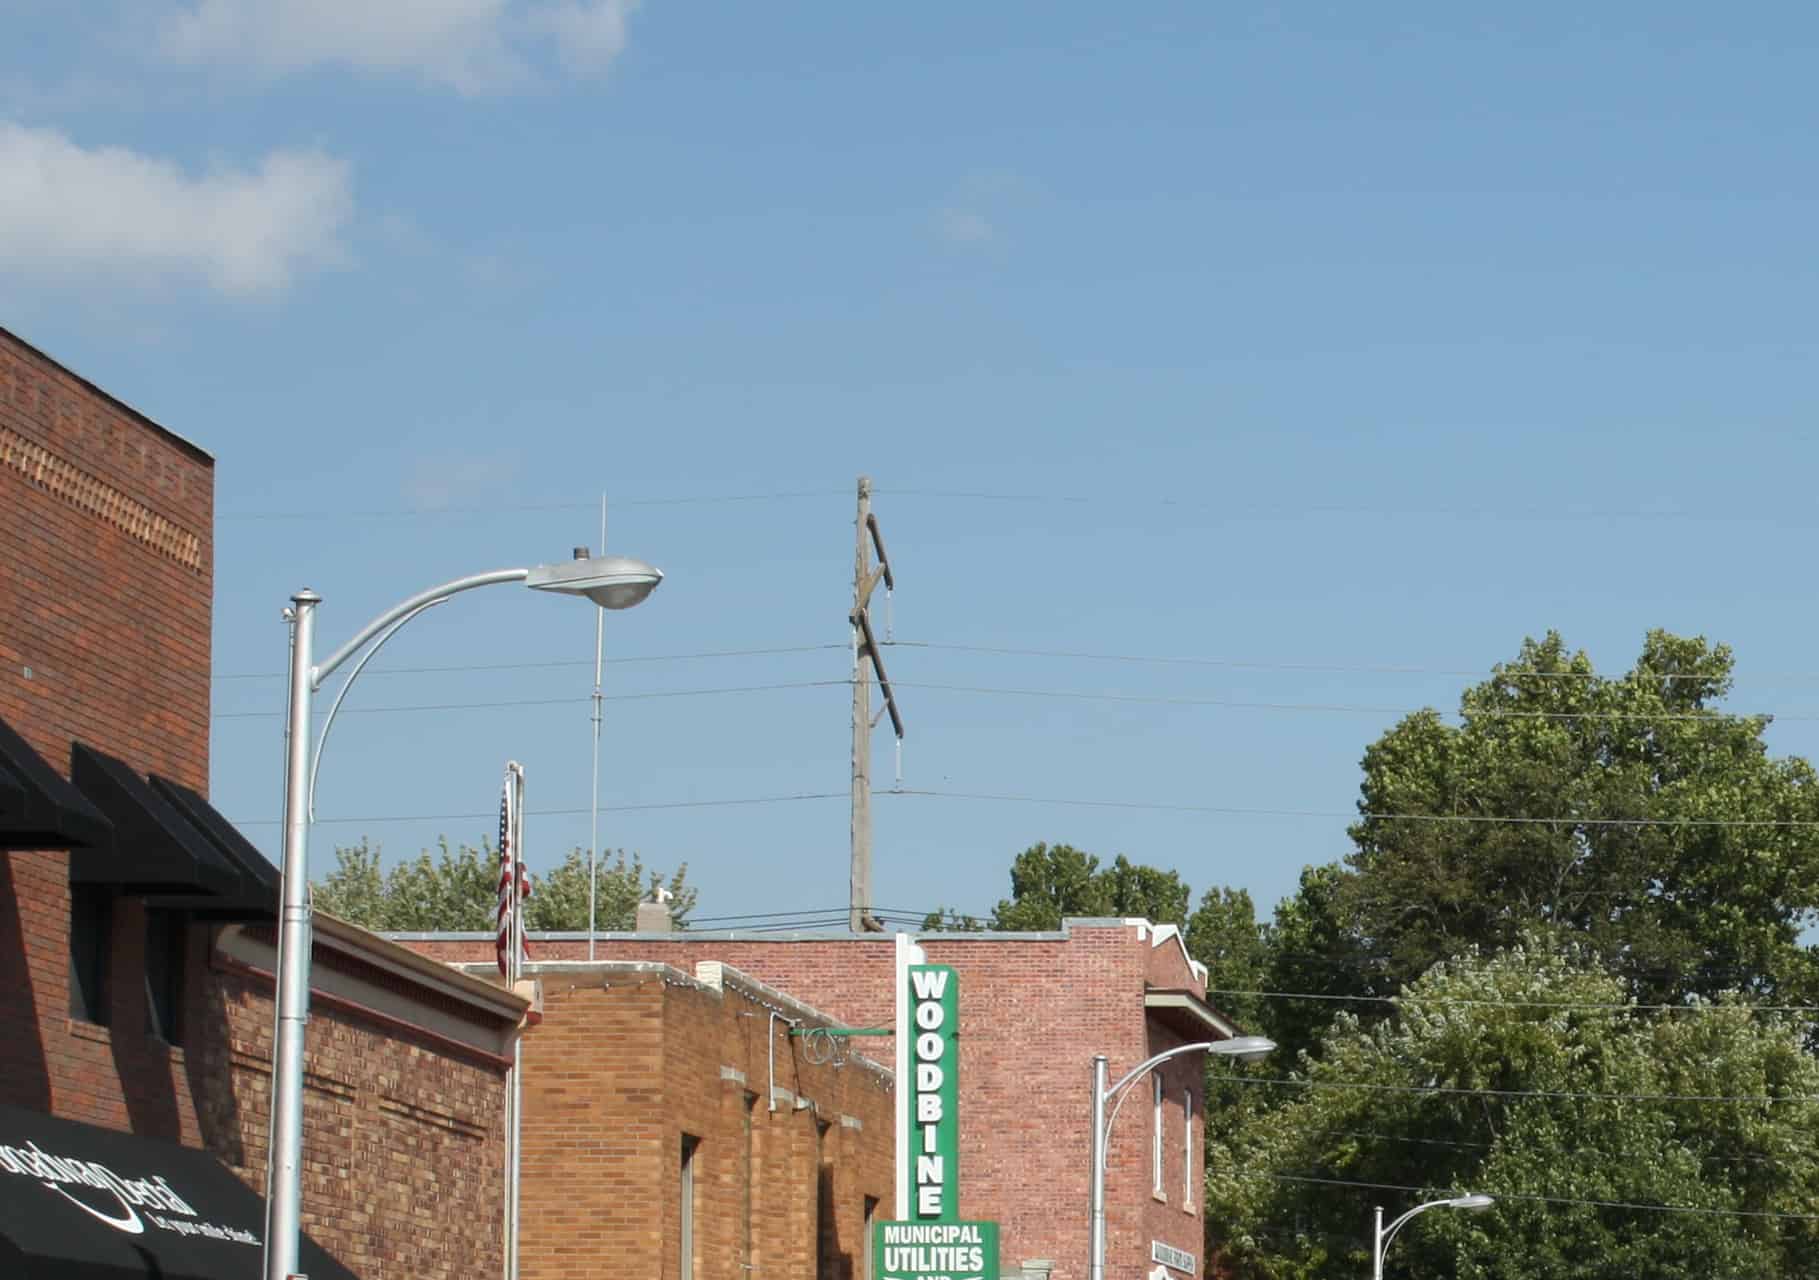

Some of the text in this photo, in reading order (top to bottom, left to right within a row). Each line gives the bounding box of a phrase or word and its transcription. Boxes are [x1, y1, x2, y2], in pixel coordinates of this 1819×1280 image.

[911, 970, 949, 1215] WOODBINE
[884, 1225, 983, 1244] MUNICIPAL
[884, 1246, 984, 1272] UTILITIES
